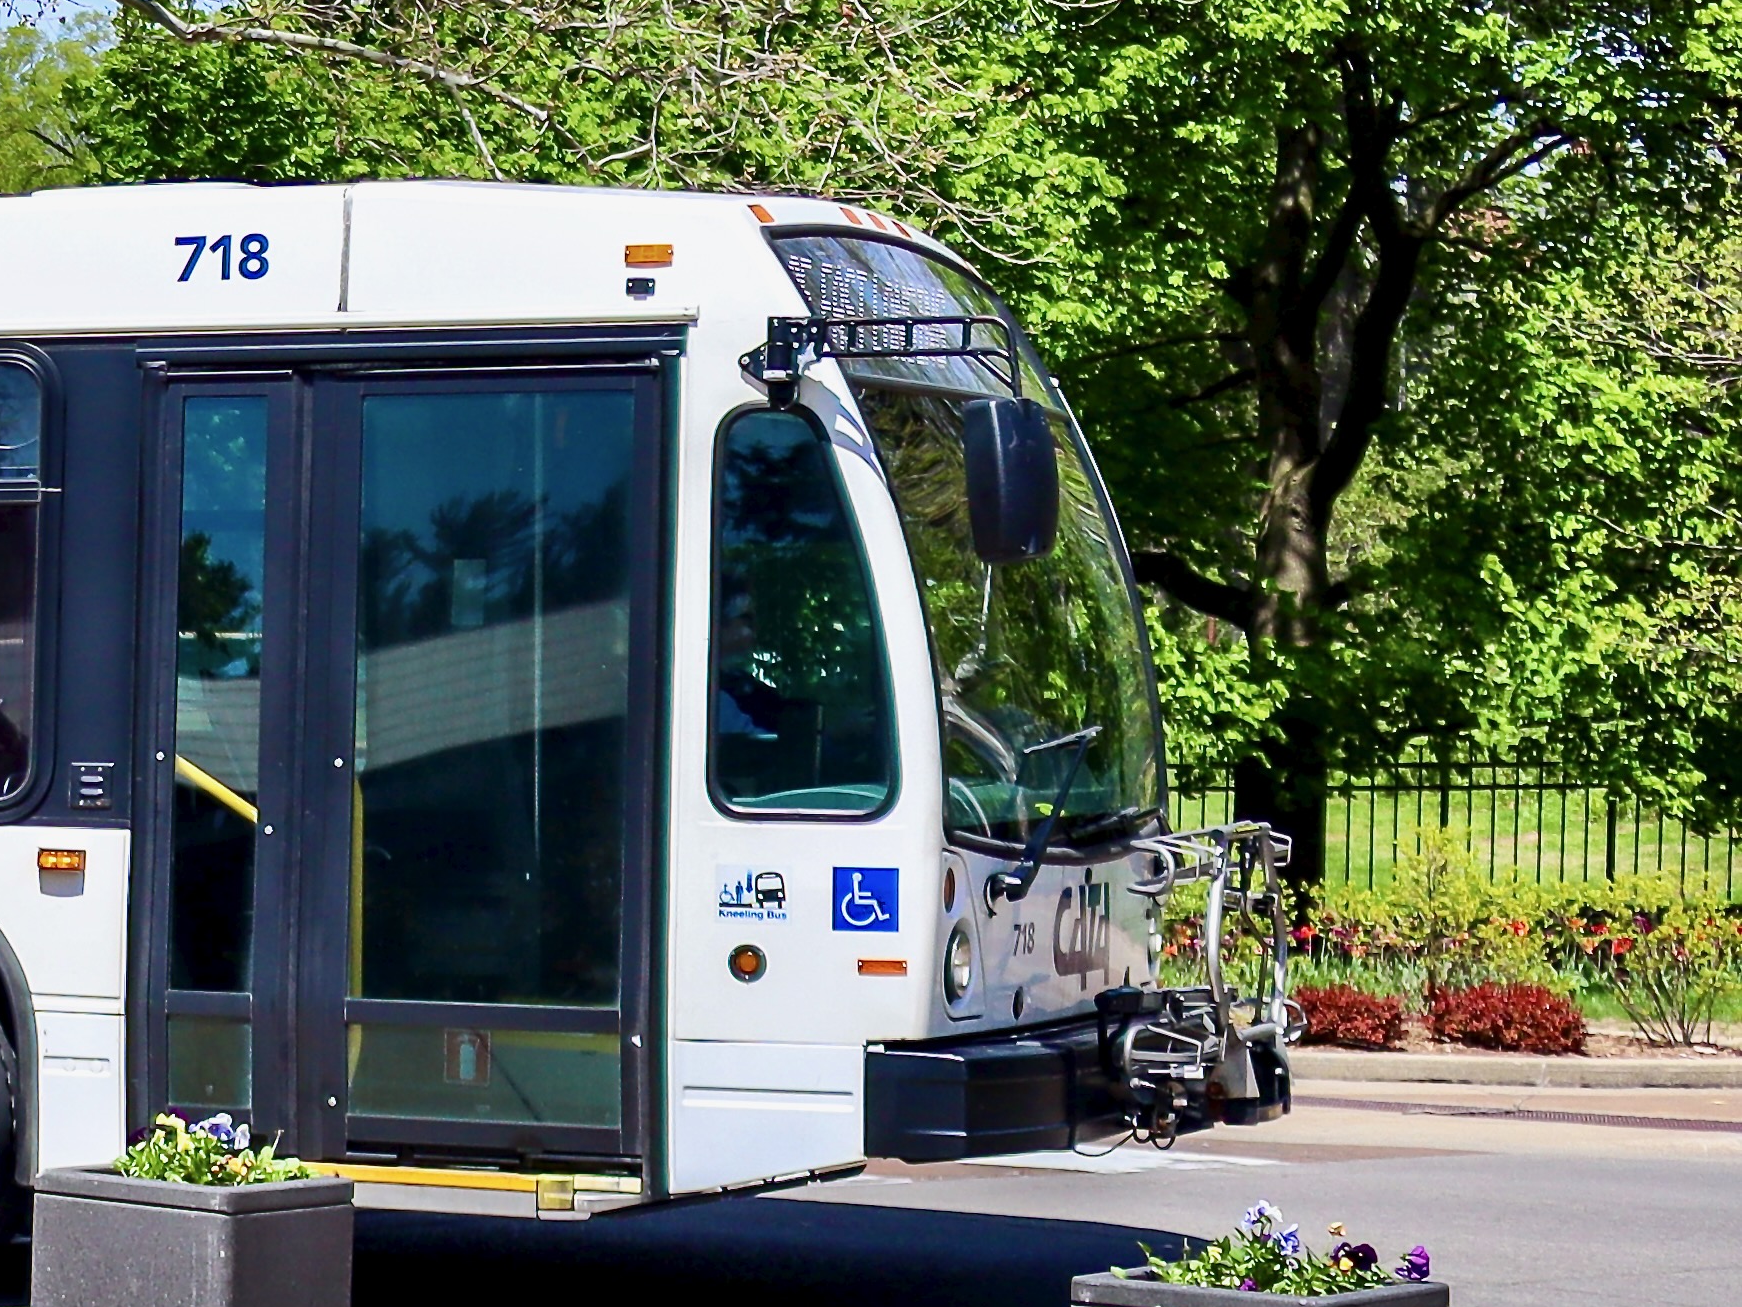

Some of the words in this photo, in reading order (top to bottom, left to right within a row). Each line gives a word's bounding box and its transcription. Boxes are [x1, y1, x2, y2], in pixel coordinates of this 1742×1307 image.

[174, 233, 269, 282] 718
[719, 910, 764, 922] Kneeling
[767, 910, 787, 920] Bus
[1013, 922, 1035, 956] 718
[1053, 882, 1110, 992] CATA
